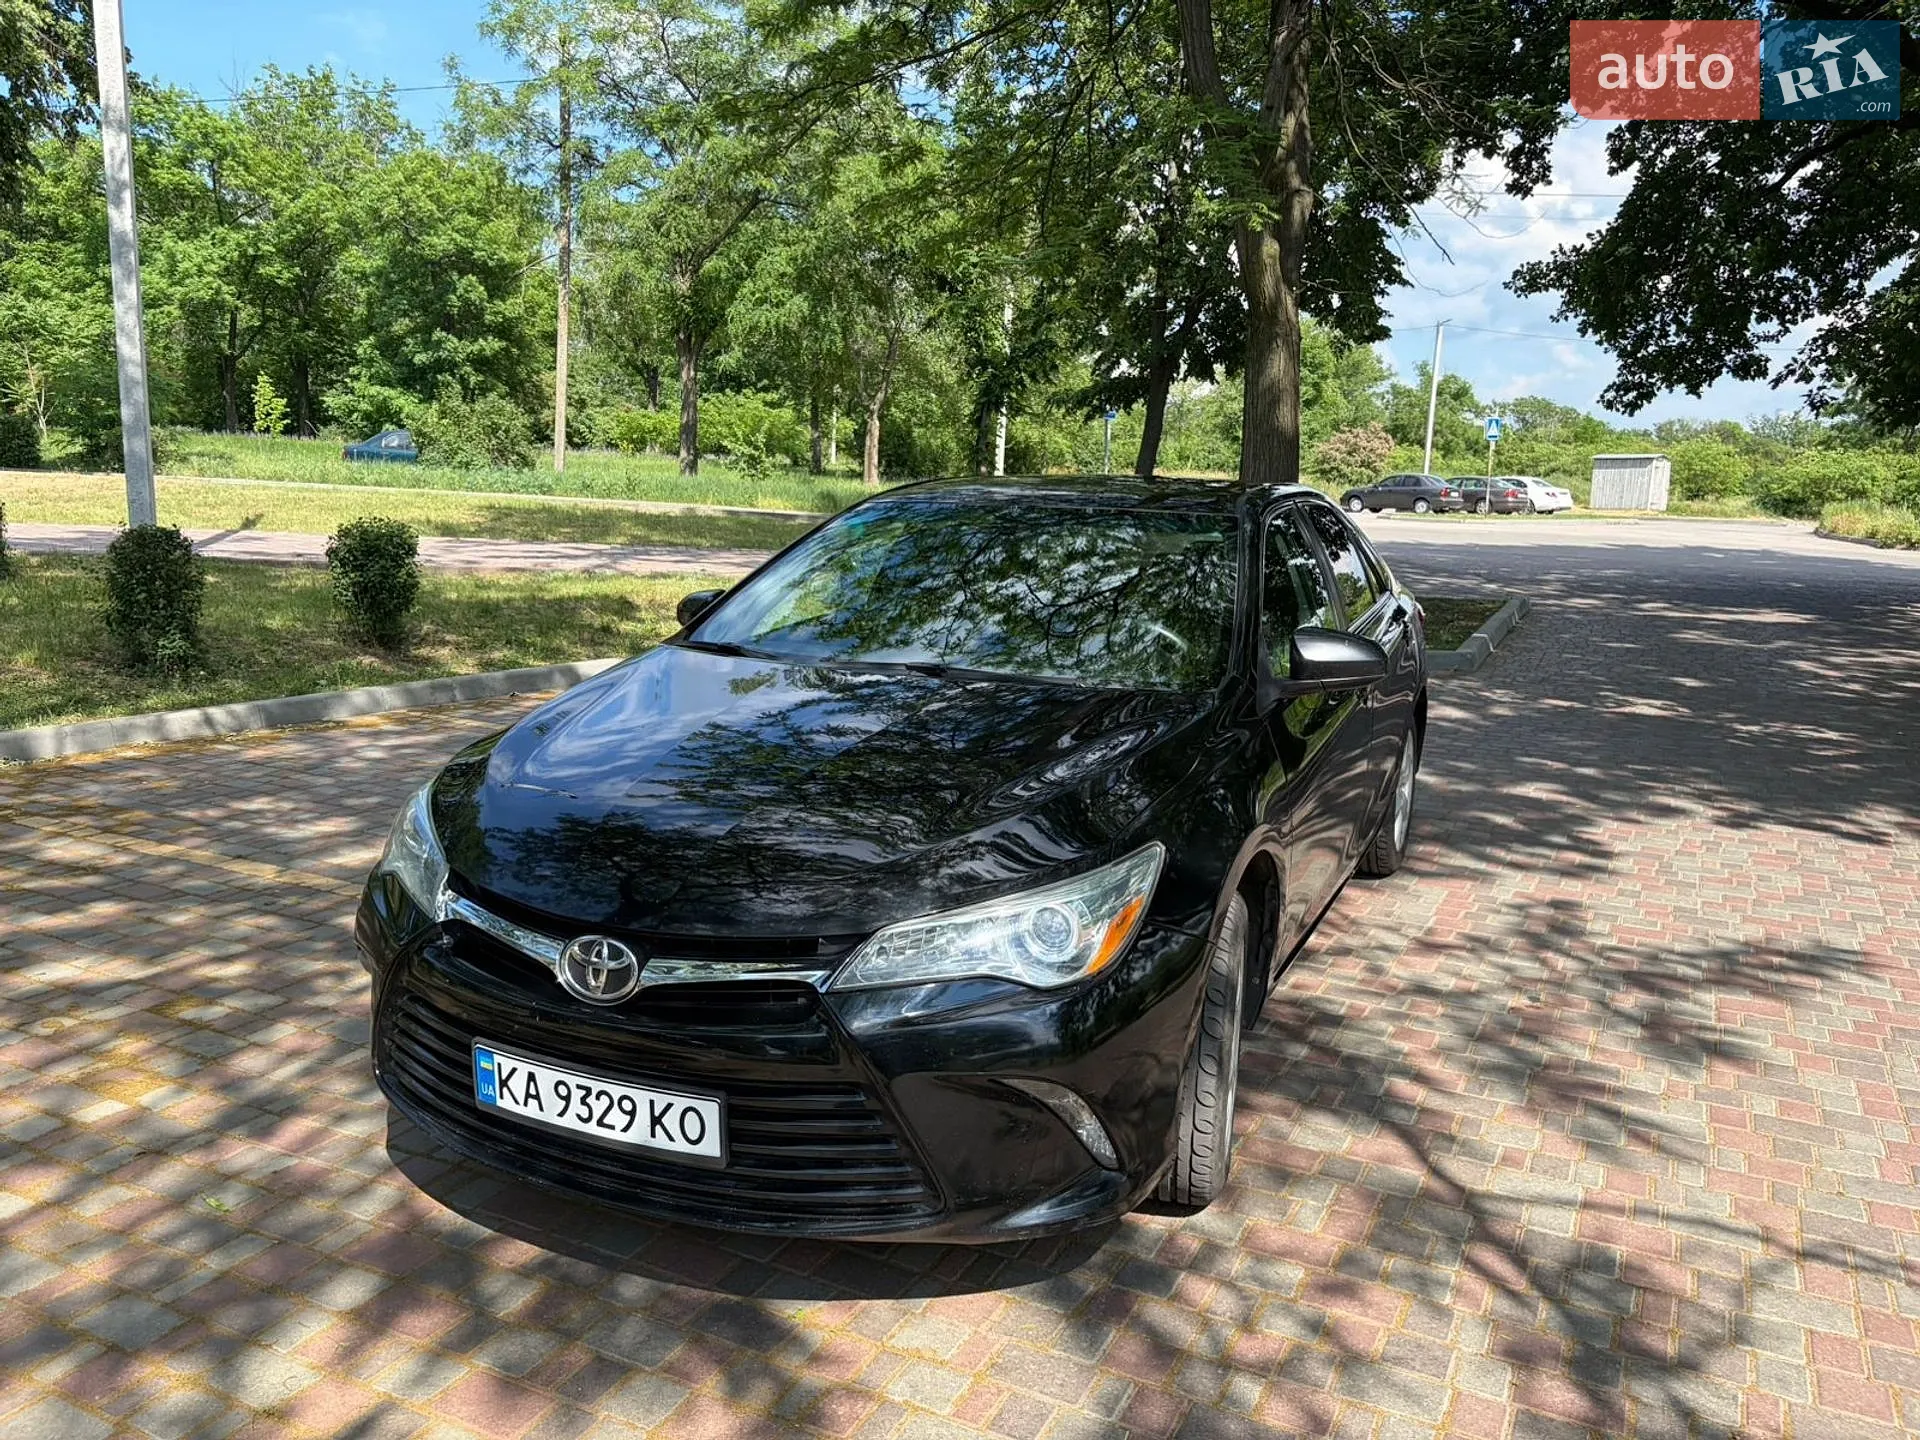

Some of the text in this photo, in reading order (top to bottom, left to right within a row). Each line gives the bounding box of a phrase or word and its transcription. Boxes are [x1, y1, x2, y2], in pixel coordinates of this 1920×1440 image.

[480, 1081, 496, 1098] UA
[496, 1062, 707, 1146] KA 9329 KO
